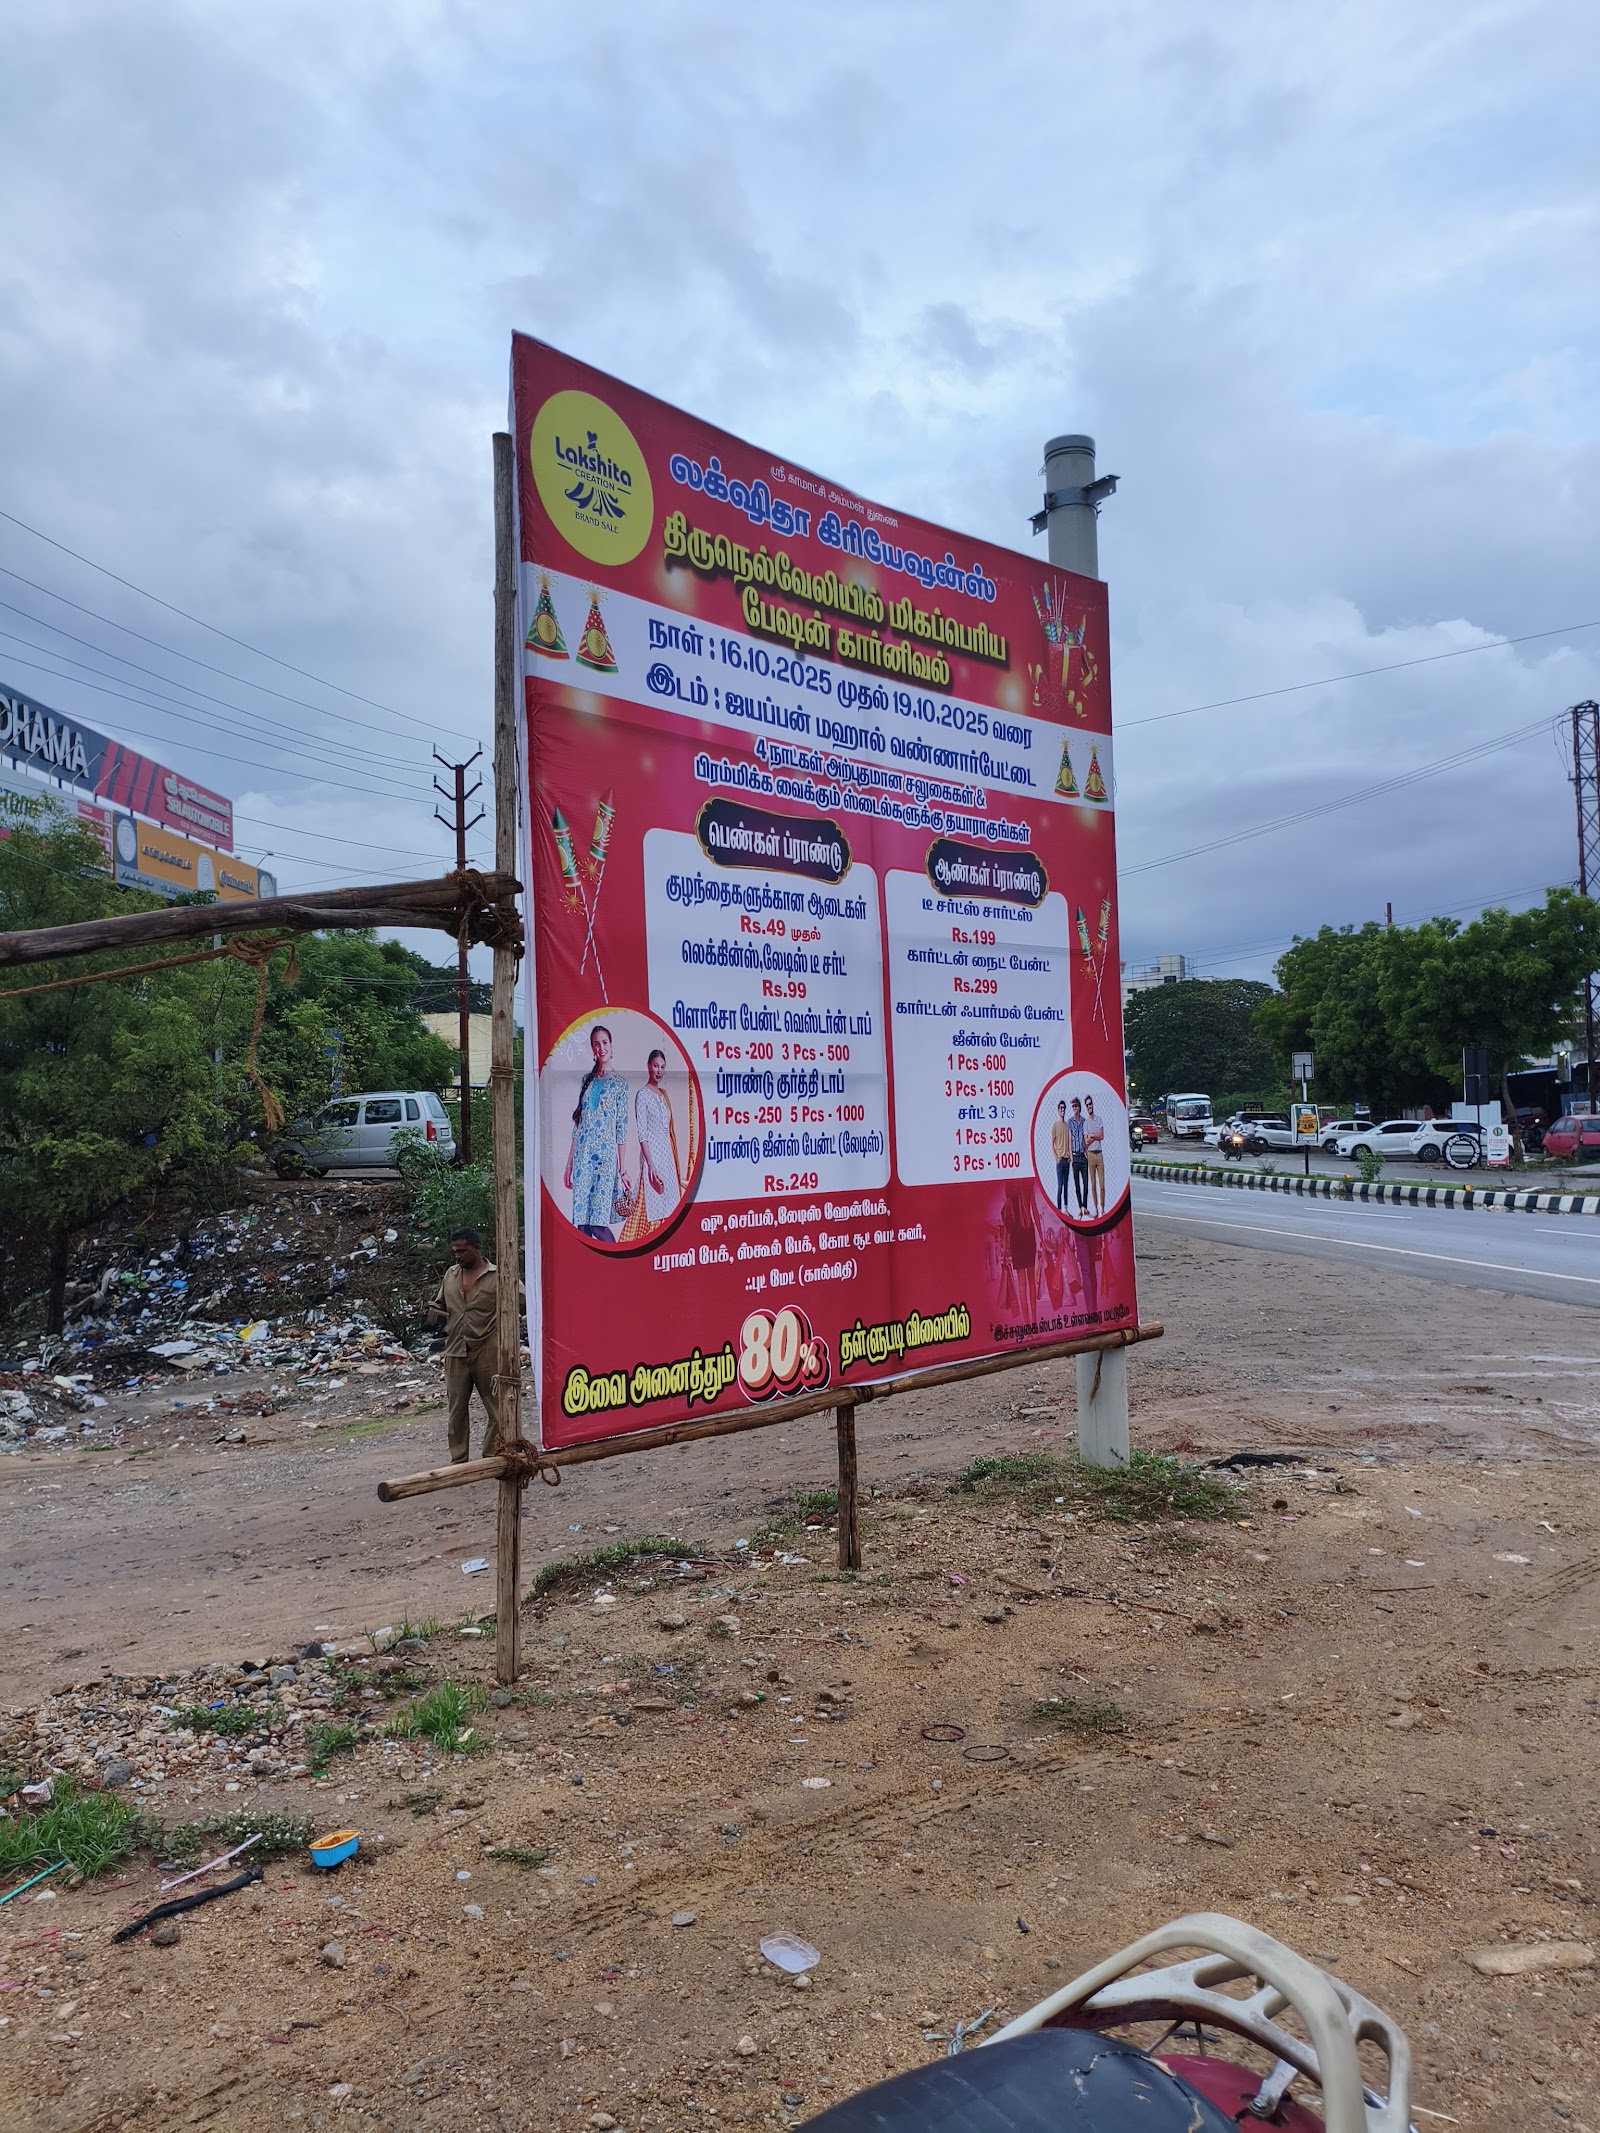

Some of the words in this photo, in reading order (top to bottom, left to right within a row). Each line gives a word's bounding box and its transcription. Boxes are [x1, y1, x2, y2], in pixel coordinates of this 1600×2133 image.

[555, 435, 632, 488] Lakshita
[575, 469, 615, 491] CREATION
[788, 474, 827, 499] காமாட்சி
[829, 491, 865, 514] அம்மன்
[867, 508, 899, 528] துணை
[575, 511, 600, 527] BRAND
[601, 521, 619, 535] SALE
[817, 510, 997, 603] கிரியேஷன்ஸ்
[664, 510, 884, 624] திருநெல்வேலியில்
[889, 597, 1006, 662] மிகப்பெரிய
[742, 586, 831, 650] பேஷன்
[837, 627, 950, 686] கார்னிவல்
[648, 618, 704, 657] நாள்
[720, 638, 832, 695] 16.10.2025
[837, 679, 889, 713] முதல்
[893, 690, 989, 737] 19.10.2025
[993, 720, 1033, 750] வரை
[646, 662, 709, 707] இடம்
[816, 717, 886, 753] மஹால்
[890, 736, 1037, 788] வண்ணார்பேட்டை
[755, 737, 767, 760] 4
[769, 744, 824, 774] நாட்கள்
[825, 756, 903, 792] அற்புதமான
[905, 777, 975, 806] சலுகைகள்
[976, 788, 987, 808] &
[694, 754, 774, 793] பிரம்மிக்க
[776, 779, 841, 809] வைக்கும்
[844, 789, 944, 830] ஸ்டைல்களுக்கு
[945, 812, 1031, 844] தயாராகுங்கள்
[708, 820, 780, 857] பெண்கள்
[783, 830, 843, 873] ப்ராண்டு
[935, 856, 990, 887] ஆண்கள்
[992, 862, 1040, 898] ப்ராண்டு
[666, 871, 805, 914] குழந்தைகளுக்கான
[807, 892, 867, 920] ஆடைகள்
[936, 898, 980, 917] சர்ட்ஸ்
[983, 905, 1033, 922] சார்ட்ஸ்
[740, 915, 786, 937] Rs.49
[790, 926, 821, 942] முதல்
[952, 927, 996, 946] Rs.199
[822, 950, 848, 977] சர்ட்
[907, 948, 969, 967] கார்ட்டன்
[972, 954, 1007, 973] நைட்
[1010, 954, 1051, 973] பேன்ட்
[762, 979, 807, 1000] Rs.99
[954, 977, 998, 995] Rs.299
[672, 999, 737, 1030] பிளாசோ
[740, 1003, 782, 1032] பேன்ட்
[784, 1007, 847, 1035] வெஸ்டர்ன்
[849, 1010, 872, 1036] டாப்
[896, 999, 957, 1018] கார்ட்டன்
[961, 1004, 1022, 1020] ஃபார்மல்
[1024, 1005, 1065, 1021] பேன்ட்
[703, 1040, 710, 1059] 1
[715, 1041, 741, 1059] Pcs
[782, 1043, 789, 1061] 3
[793, 1043, 816, 1061] Pcs
[827, 1044, 850, 1062] 500
[952, 1029, 997, 1048] ஜீன்ஸ்
[999, 1032, 1041, 1048] பேன்ட்
[947, 1054, 953, 1071] 1
[958, 1054, 979, 1071] Pcs
[716, 1066, 774, 1100] ப்ராண்டு
[776, 1068, 819, 1102] குர்த்தி
[821, 1068, 845, 1094] டாப்
[945, 1080, 952, 1097] 3
[956, 1080, 976, 1097] Pcs
[987, 1080, 1014, 1096] 1500
[712, 1107, 719, 1125] 1
[725, 1107, 750, 1125] Pcs
[790, 1106, 798, 1123] 5
[802, 1105, 825, 1123] Pcs
[835, 1105, 864, 1121] 1000
[958, 1104, 985, 1120] சர்ட்
[988, 1105, 998, 1120] 3
[1001, 1105, 1015, 1119] Pcs
[708, 1136, 760, 1164] ப்ராண்டு
[762, 1130, 800, 1158] ஜீன்ஸ்
[802, 1131, 837, 1156] பேன்ட்
[955, 1129, 961, 1145] 1
[966, 1129, 986, 1145] Pcs
[953, 1155, 960, 1172] 3
[964, 1154, 984, 1171] Pcs
[994, 1152, 1020, 1169] 1000
[764, 1172, 819, 1192] Rs.249
[653, 1248, 696, 1273] ட்ராலி
[737, 1239, 782, 1260] ஸ்கூல்
[818, 1232, 851, 1251] கோட்
[874, 1229, 896, 1245] பெட்
[770, 1269, 796, 1288] மேட்
[564, 1367, 627, 1414] இவை
[630, 1344, 736, 1405] அனைத்தும்
[739, 1309, 820, 1387] 80%
[840, 1320, 905, 1367] தள்ளுபடி
[905, 1305, 970, 1346] விலையில்
